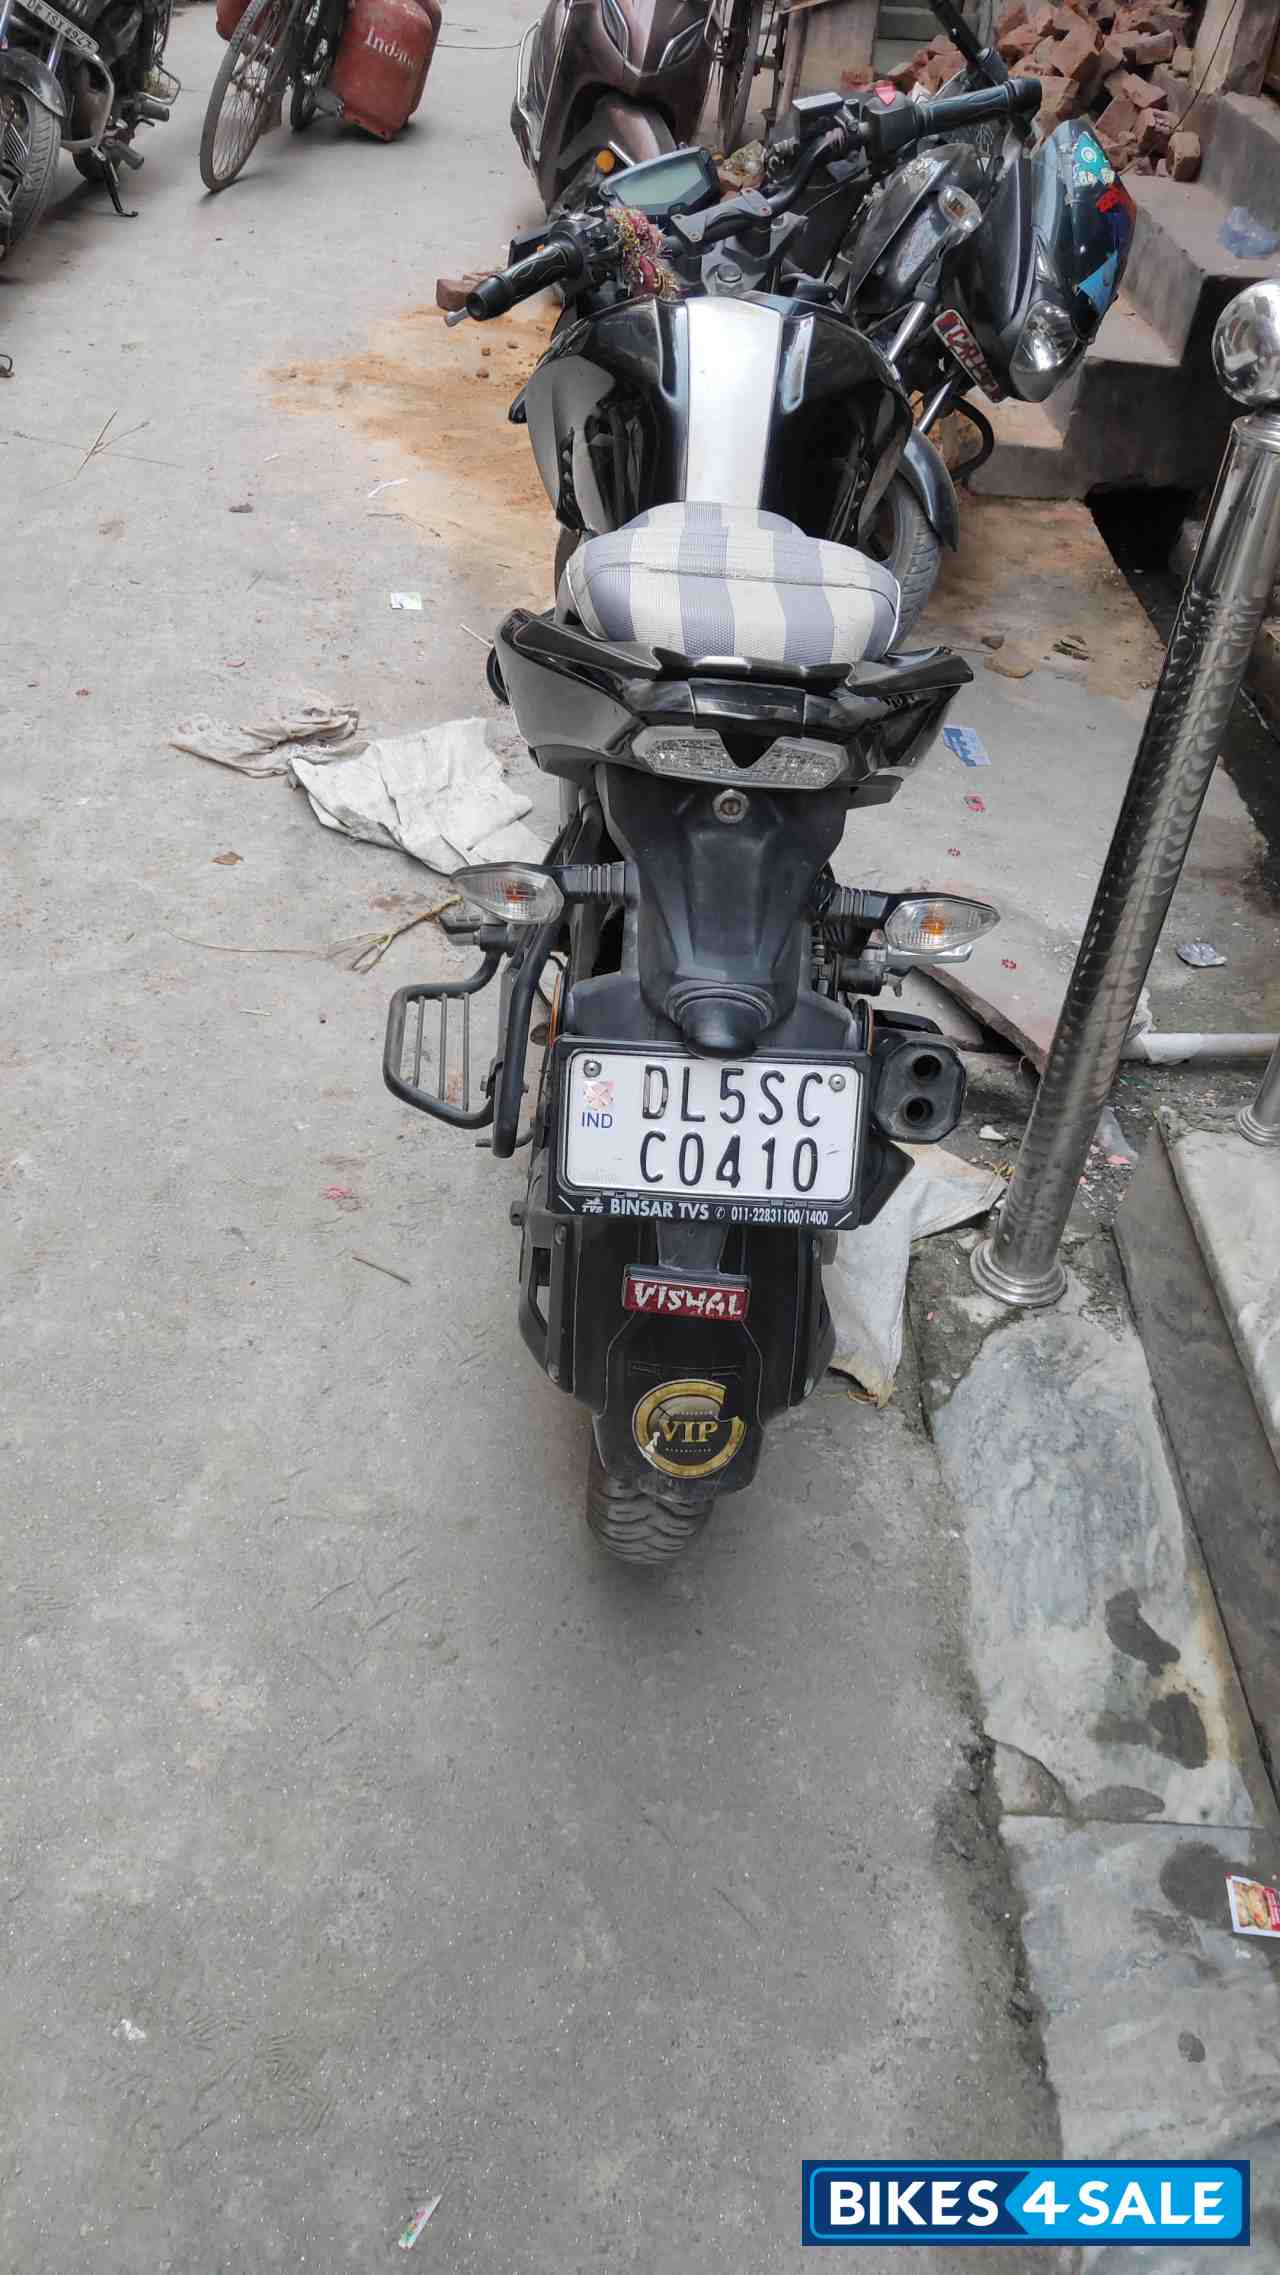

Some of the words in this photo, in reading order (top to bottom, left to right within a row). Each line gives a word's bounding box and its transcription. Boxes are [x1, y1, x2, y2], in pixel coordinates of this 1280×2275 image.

[642, 1064, 823, 1127] DL5SC
[580, 1112, 613, 1129] IND
[640, 1131, 818, 1192] C0410
[610, 1198, 673, 1217] BINSAR
[678, 1202, 709, 1220] TVS
[731, 1206, 829, 1225] 011-22831100/1400
[661, 1420, 718, 1443] VIP
